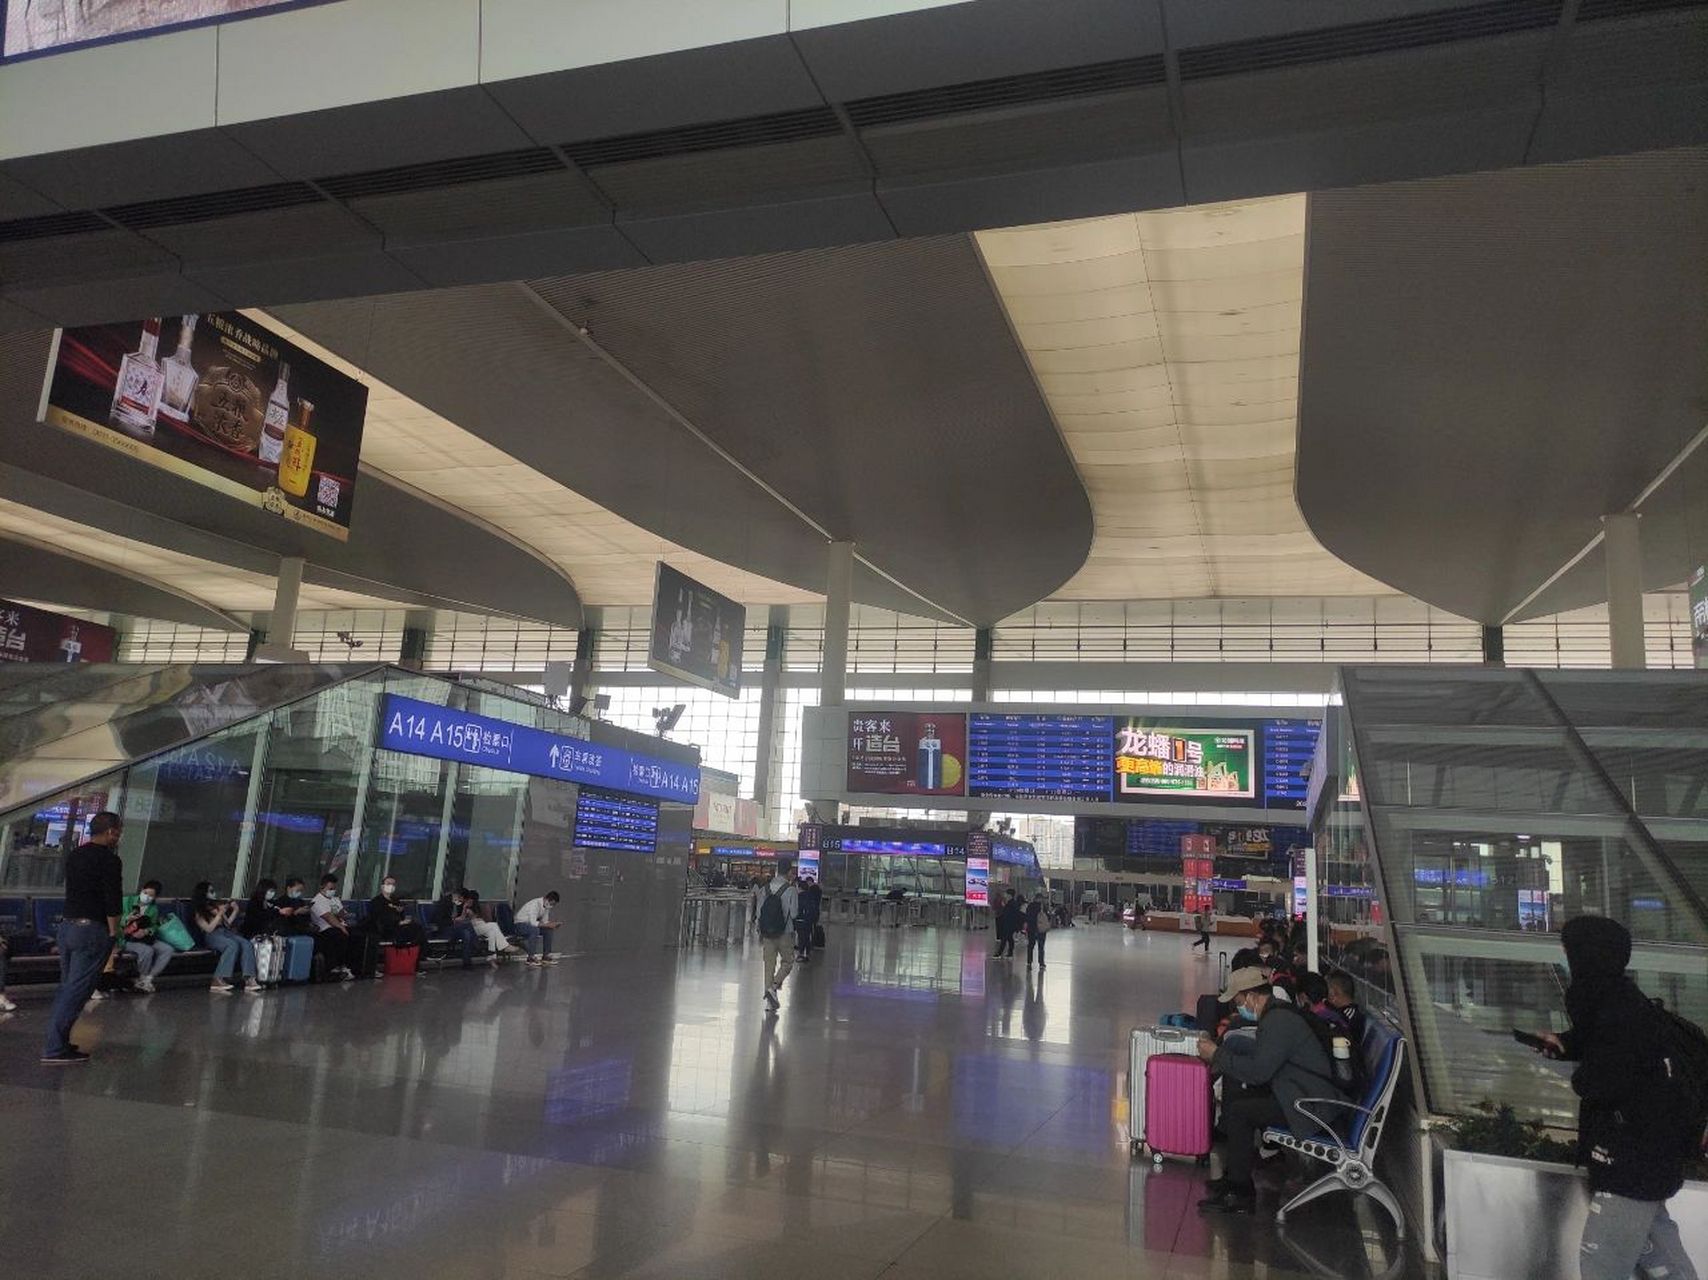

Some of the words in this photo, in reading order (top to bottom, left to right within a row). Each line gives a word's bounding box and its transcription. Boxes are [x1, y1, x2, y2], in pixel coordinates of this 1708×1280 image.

[388, 711, 426, 741] A14
[429, 719, 464, 748] A15
[661, 771, 679, 789] A14
[682, 776, 699, 795] A15
